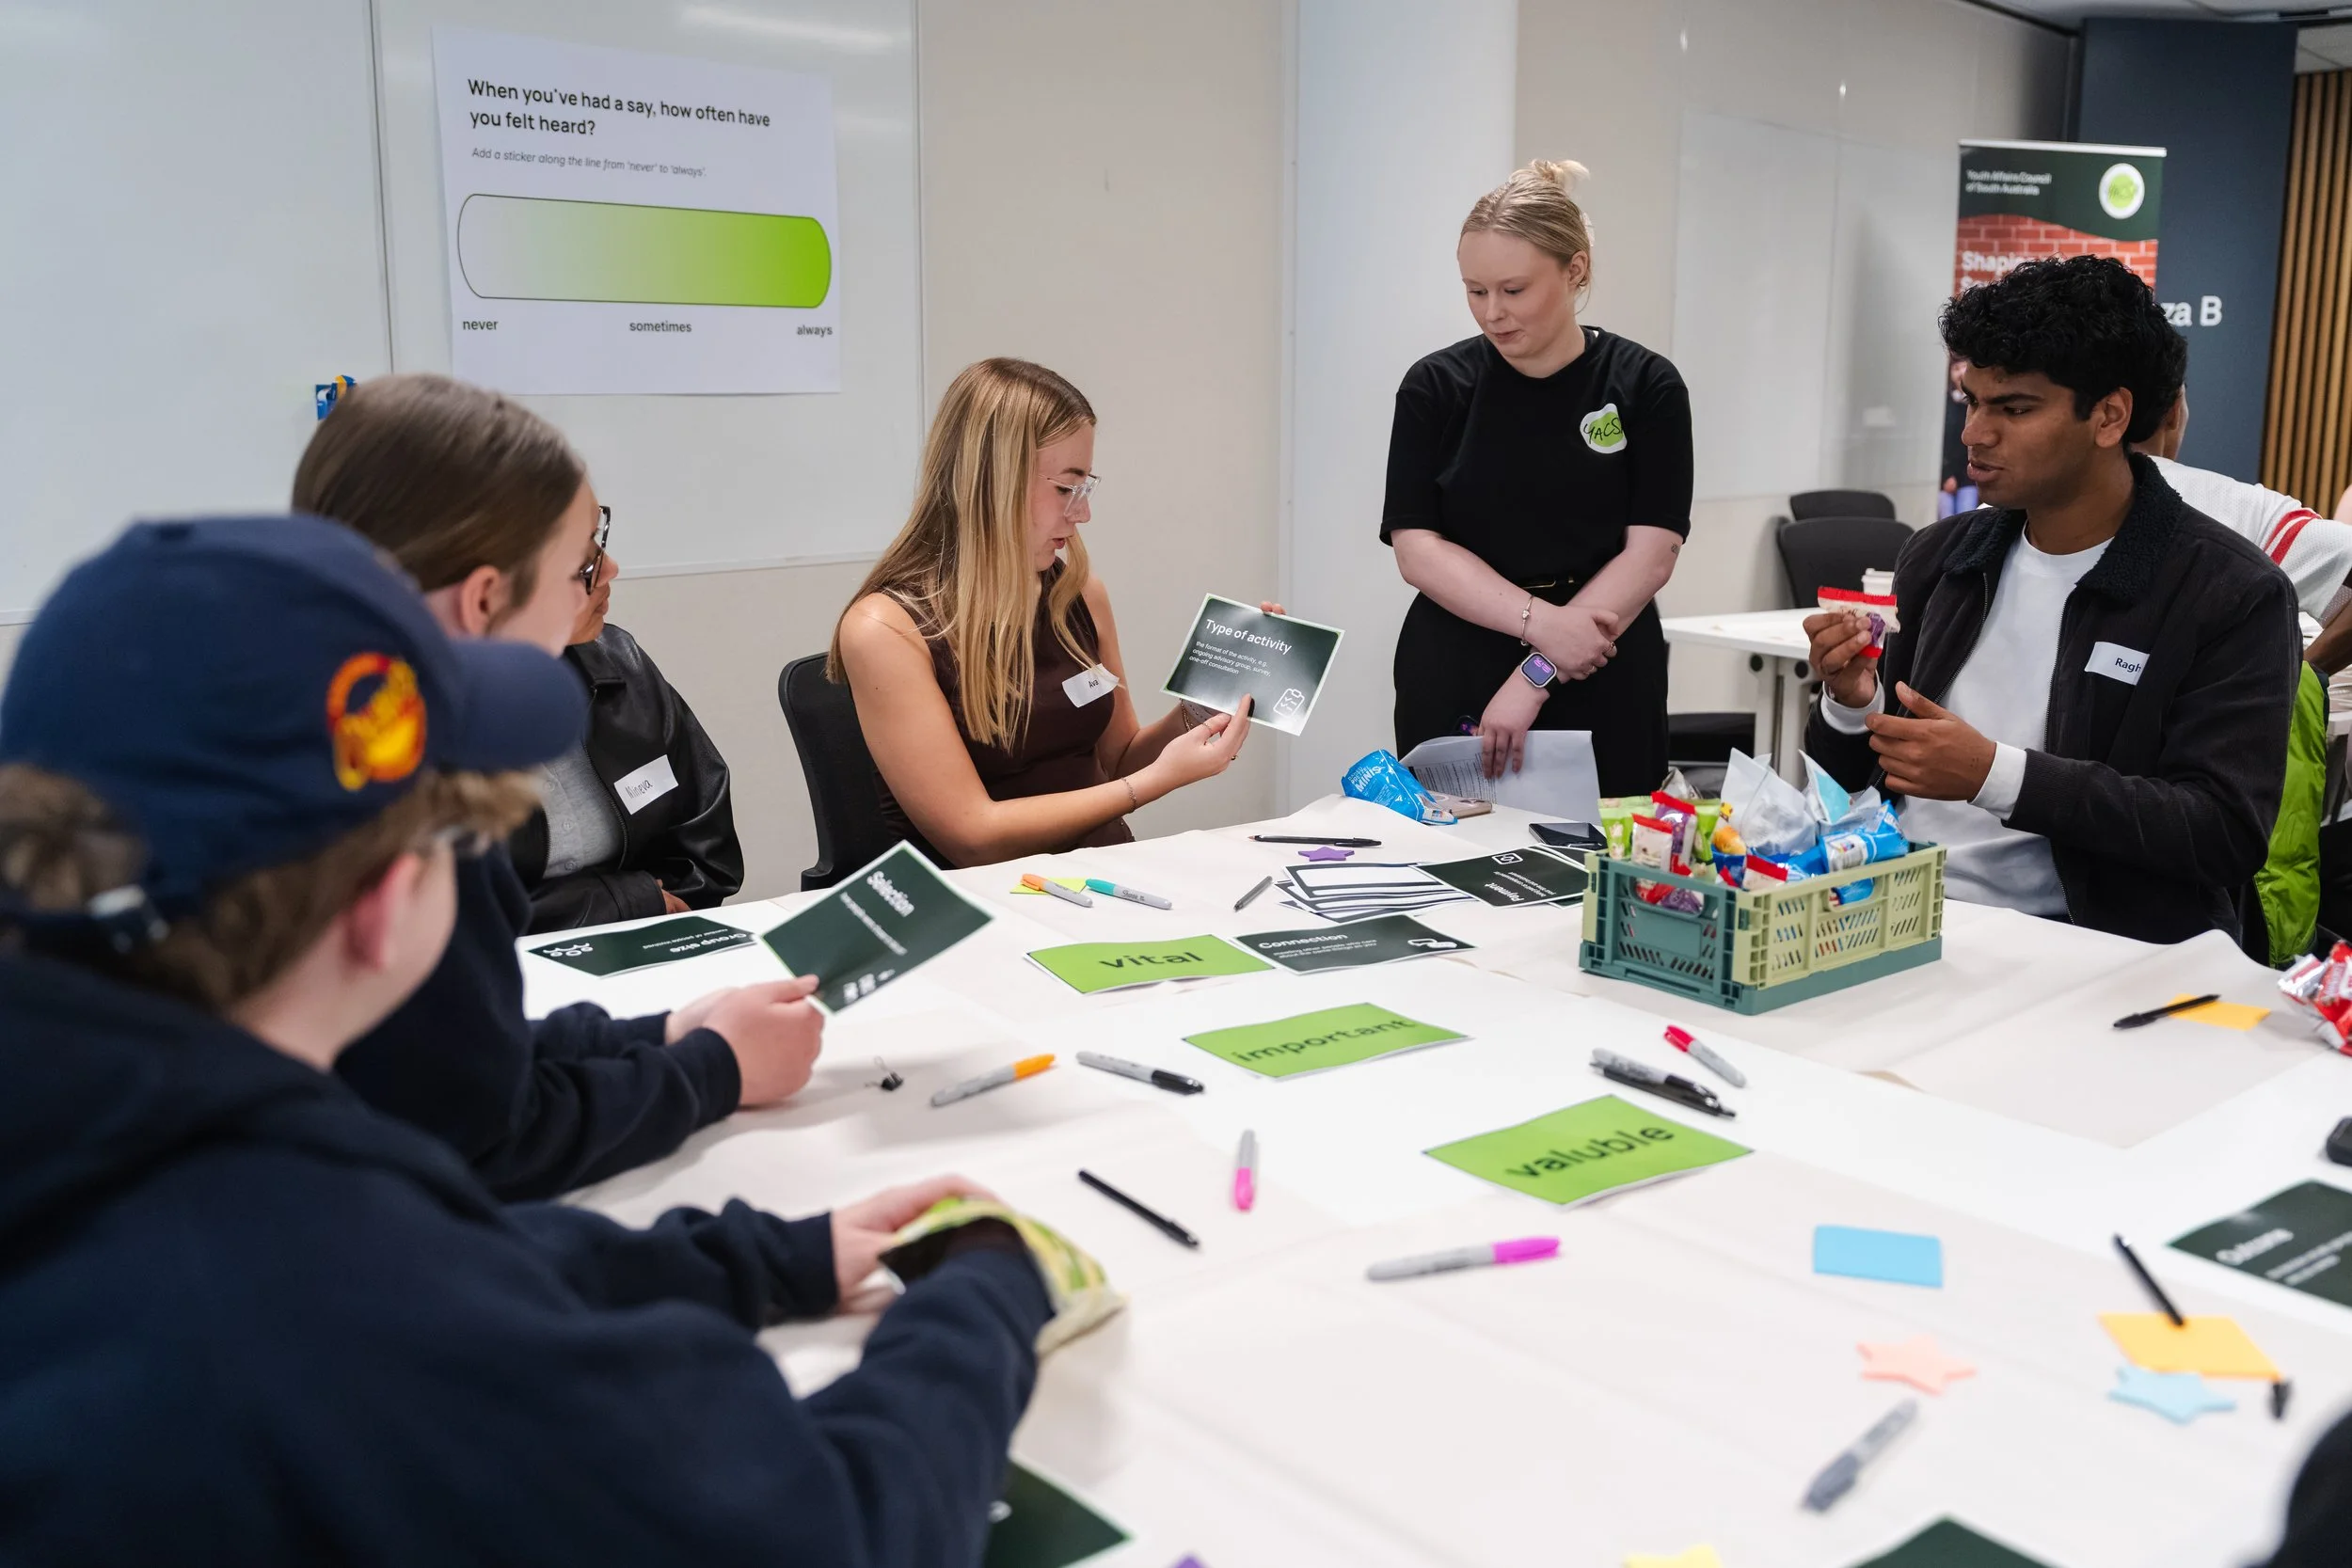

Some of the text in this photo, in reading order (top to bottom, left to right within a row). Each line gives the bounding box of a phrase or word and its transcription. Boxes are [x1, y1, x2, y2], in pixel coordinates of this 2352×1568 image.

[468, 79, 771, 127] When you've had a say, how often have
[470, 111, 596, 135] you felt heard?
[472, 148, 492, 158] Add
[495, 150, 501, 159] a
[504, 150, 536, 163] sticker
[538, 154, 565, 166] along
[568, 156, 582, 166] the
[585, 157, 601, 167] line
[602, 158, 625, 171] from
[660, 164, 669, 173] to
[1966, 169, 1991, 181] Youth
[2020, 171, 2052, 184] Council
[1965, 182, 2040, 196] of South Australia
[2200, 295, 2222, 326] B
[463, 319, 498, 331] never
[629, 320, 692, 333] sometimes
[796, 325, 833, 337] always
[1206, 619, 1292, 655] Type of activity
[1193, 648, 1214, 659] ongoing
[1214, 656, 1234, 665] advisory
[1205, 643, 1222, 653] format
[1237, 654, 1257, 664] activity,
[1189, 656, 1239, 674] one-off consultation
[2115, 657, 2141, 673] Ragh
[1089, 679, 1099, 689] Ava
[1355, 766, 1382, 792] MINIS
[866, 871, 914, 917] Selection
[1485, 882, 1524, 901] Payment
[670, 933, 746, 953] Group size
[1259, 934, 1348, 949] Connection
[1098, 950, 1205, 971] vital
[1232, 1018, 1417, 1065] important
[1505, 1126, 1675, 1180] valuble
